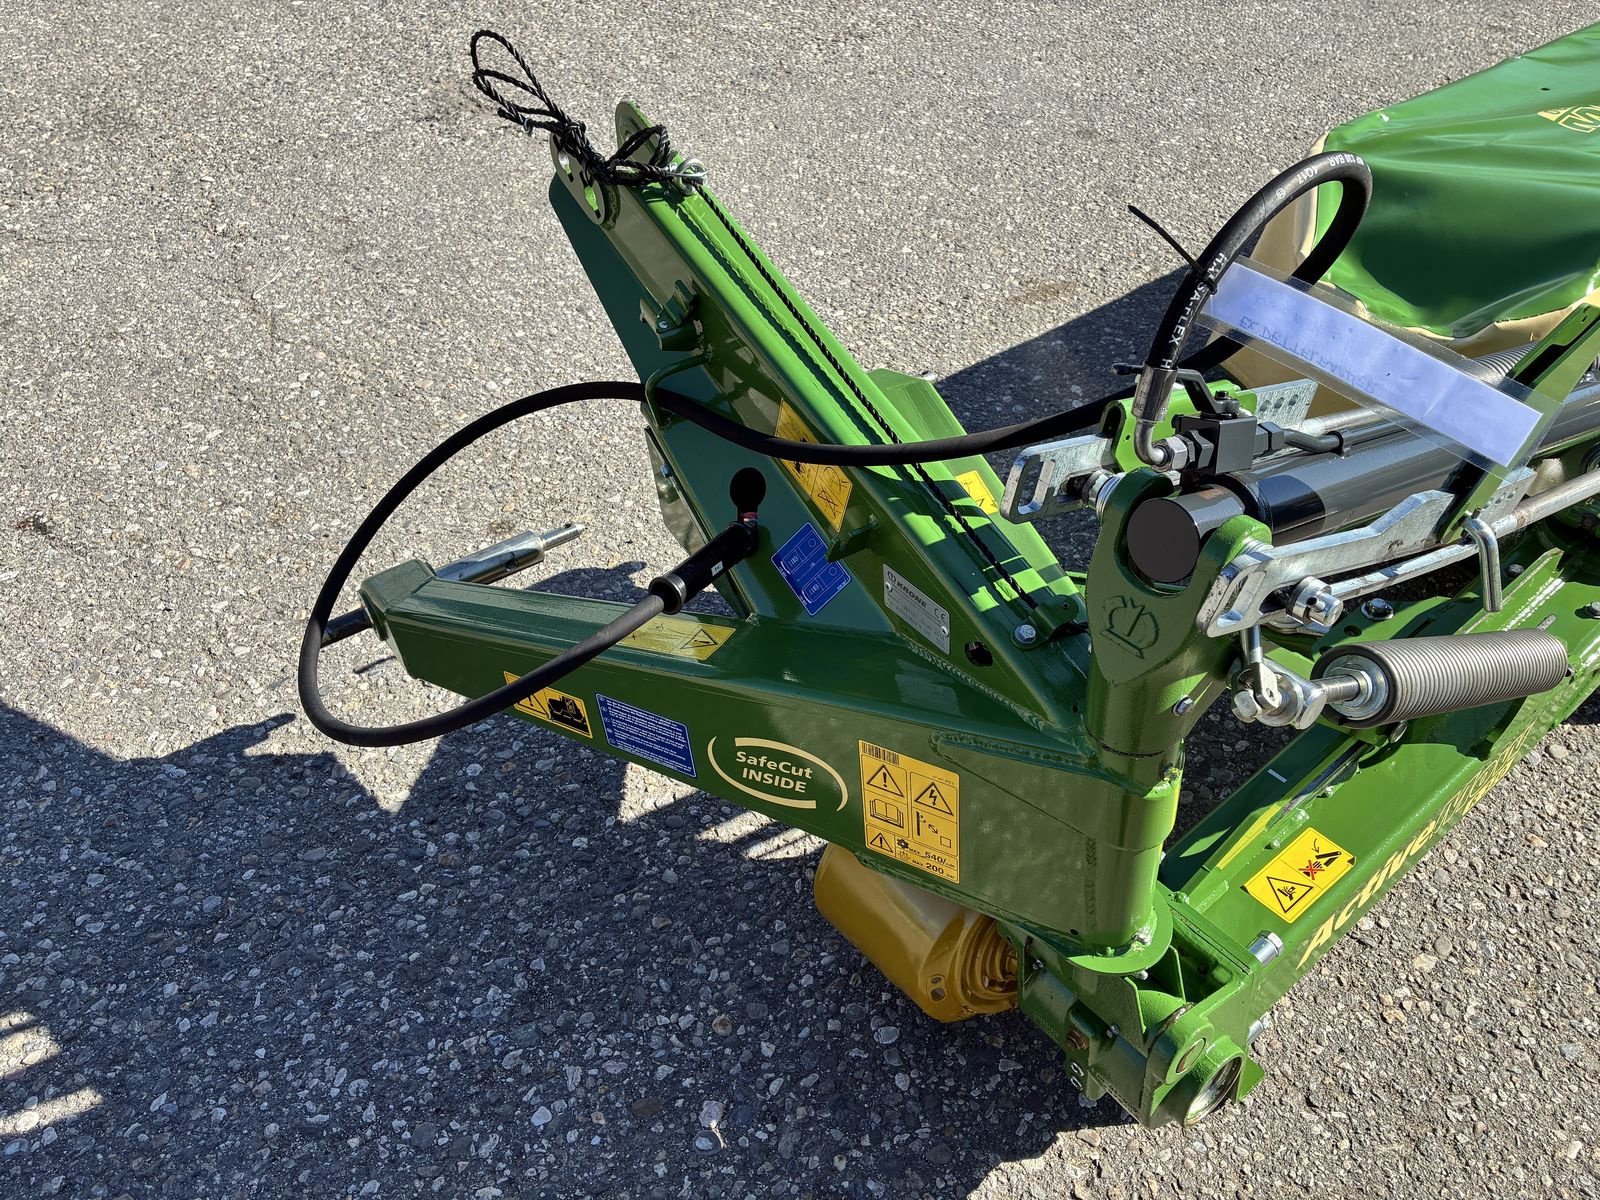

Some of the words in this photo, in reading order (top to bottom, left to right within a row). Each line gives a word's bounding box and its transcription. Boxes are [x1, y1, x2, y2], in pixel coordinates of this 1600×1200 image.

[1328, 154, 1345, 166] BAR
[896, 581, 928, 608] KRONE
[735, 751, 813, 779] SafeCut
[742, 767, 807, 793] INSIDE
[925, 862, 944, 874] 200
